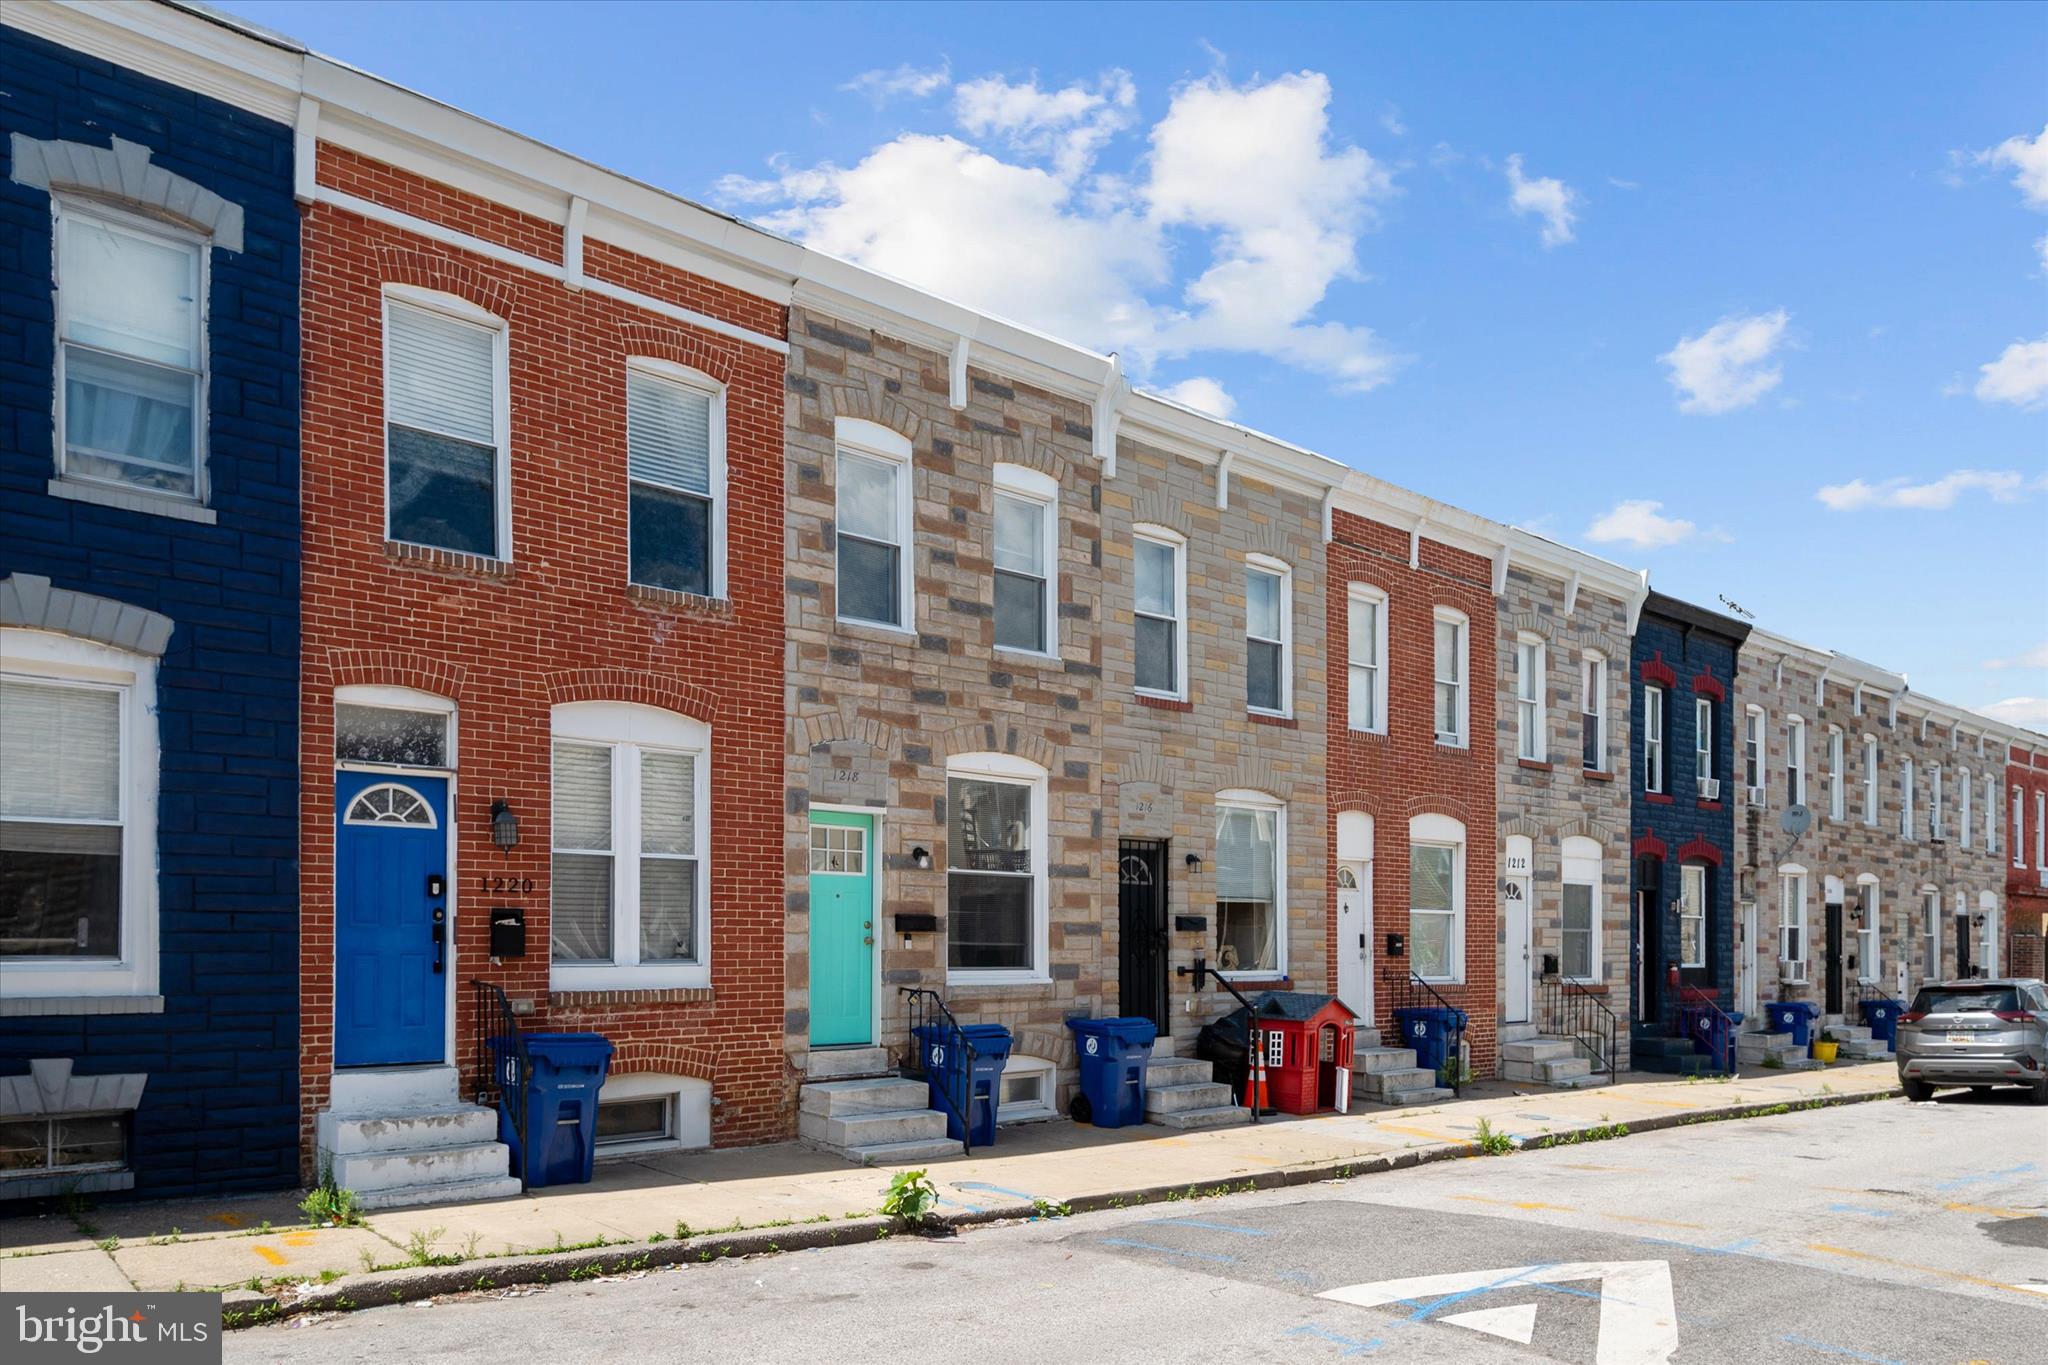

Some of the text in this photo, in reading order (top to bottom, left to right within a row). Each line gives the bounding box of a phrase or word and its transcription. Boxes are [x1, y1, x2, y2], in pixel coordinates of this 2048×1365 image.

[833, 769, 859, 782] 1218
[1508, 857, 1525, 869] 1212
[480, 877, 533, 894] 1220
